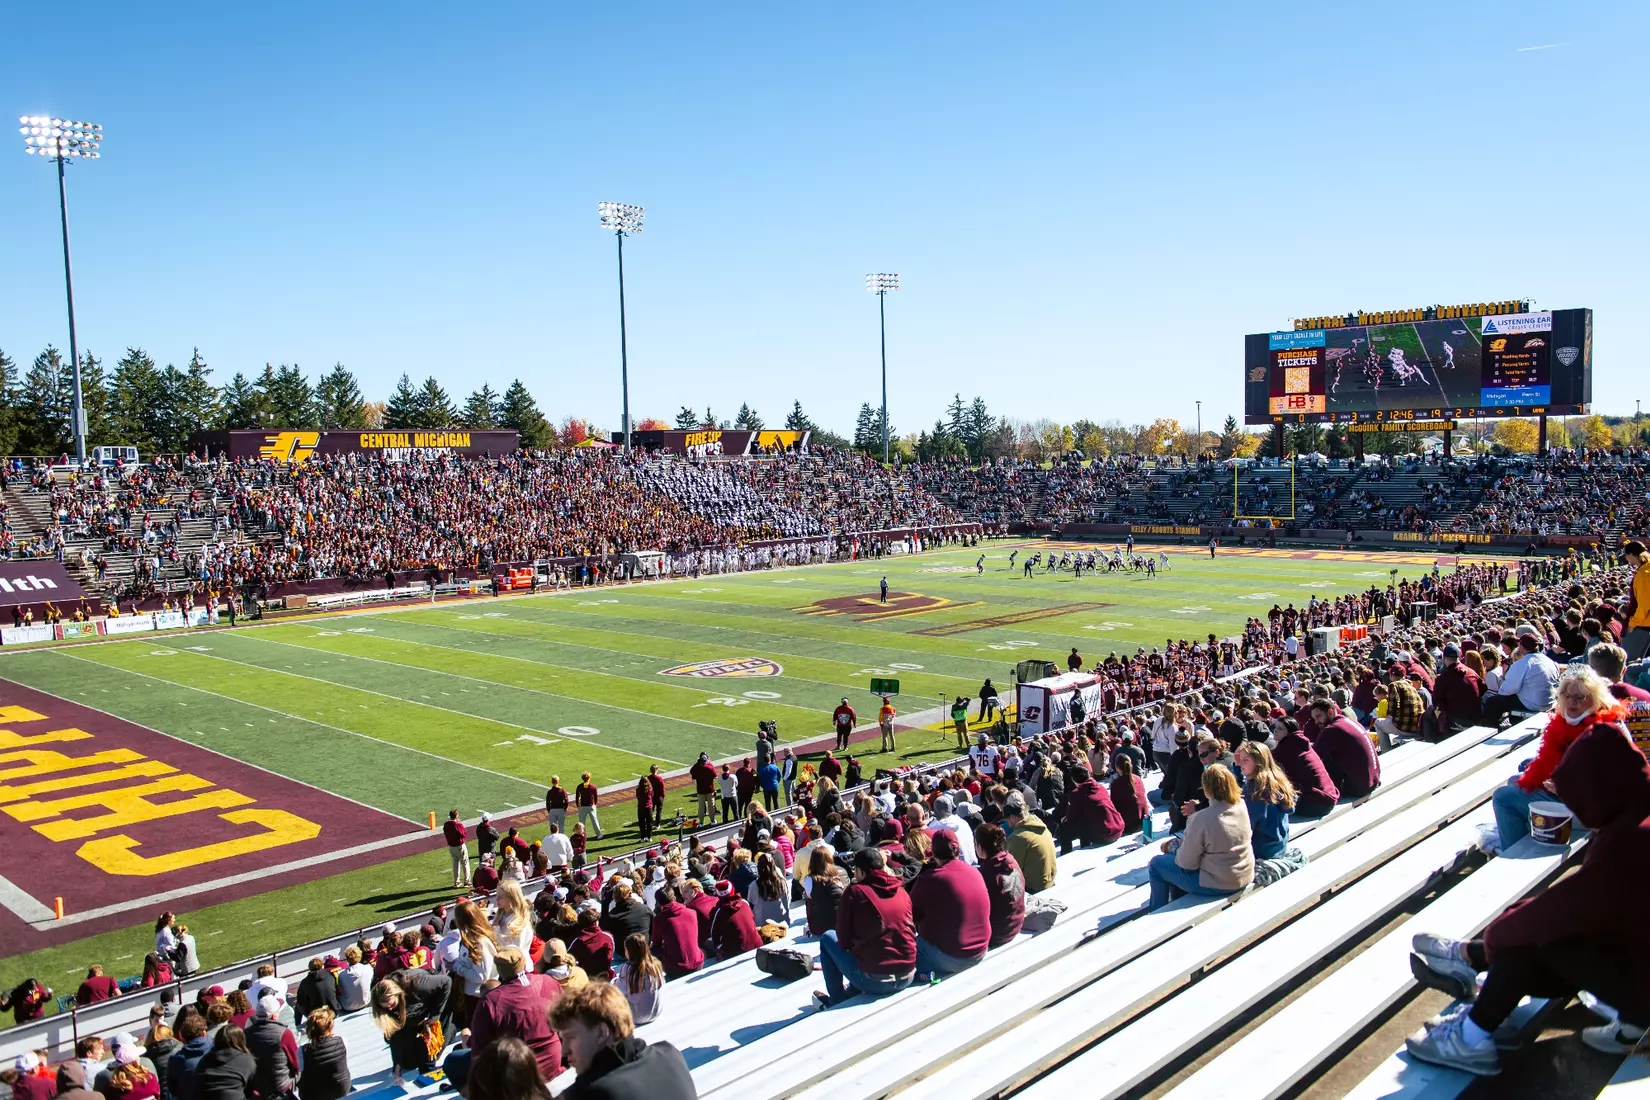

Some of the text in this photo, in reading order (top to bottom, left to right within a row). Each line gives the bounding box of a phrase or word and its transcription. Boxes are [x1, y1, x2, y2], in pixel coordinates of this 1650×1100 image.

[1294, 300, 1520, 330] CENTRAL MICHIGAN UNIVERSITY
[1498, 318, 1536, 326] LISTENING
[1278, 350, 1317, 359] PURCHASE
[1278, 357, 1317, 367] TICKETS
[1299, 413, 1304, 422] 0
[1331, 413, 1336, 421] 3
[1352, 411, 1357, 421] 3
[1377, 411, 1382, 420] 2
[1390, 410, 1413, 420] 12:46
[1431, 409, 1440, 418] 19
[1456, 408, 1461, 418] 2
[1469, 409, 1474, 417] 2
[1514, 406, 1519, 415] 7
[1577, 404, 1583, 413] 7
[1349, 421, 1454, 433] McGUIRK FAMILY SCOREBOARD
[360, 433, 471, 448] CENTRAL MICHIGAN
[685, 431, 722, 447] FIRE UP
[1469, 534, 1490, 544] FIELD
[706, 691, 782, 707] 20
[515, 726, 600, 745] 10
[976, 754, 989, 767] 76
